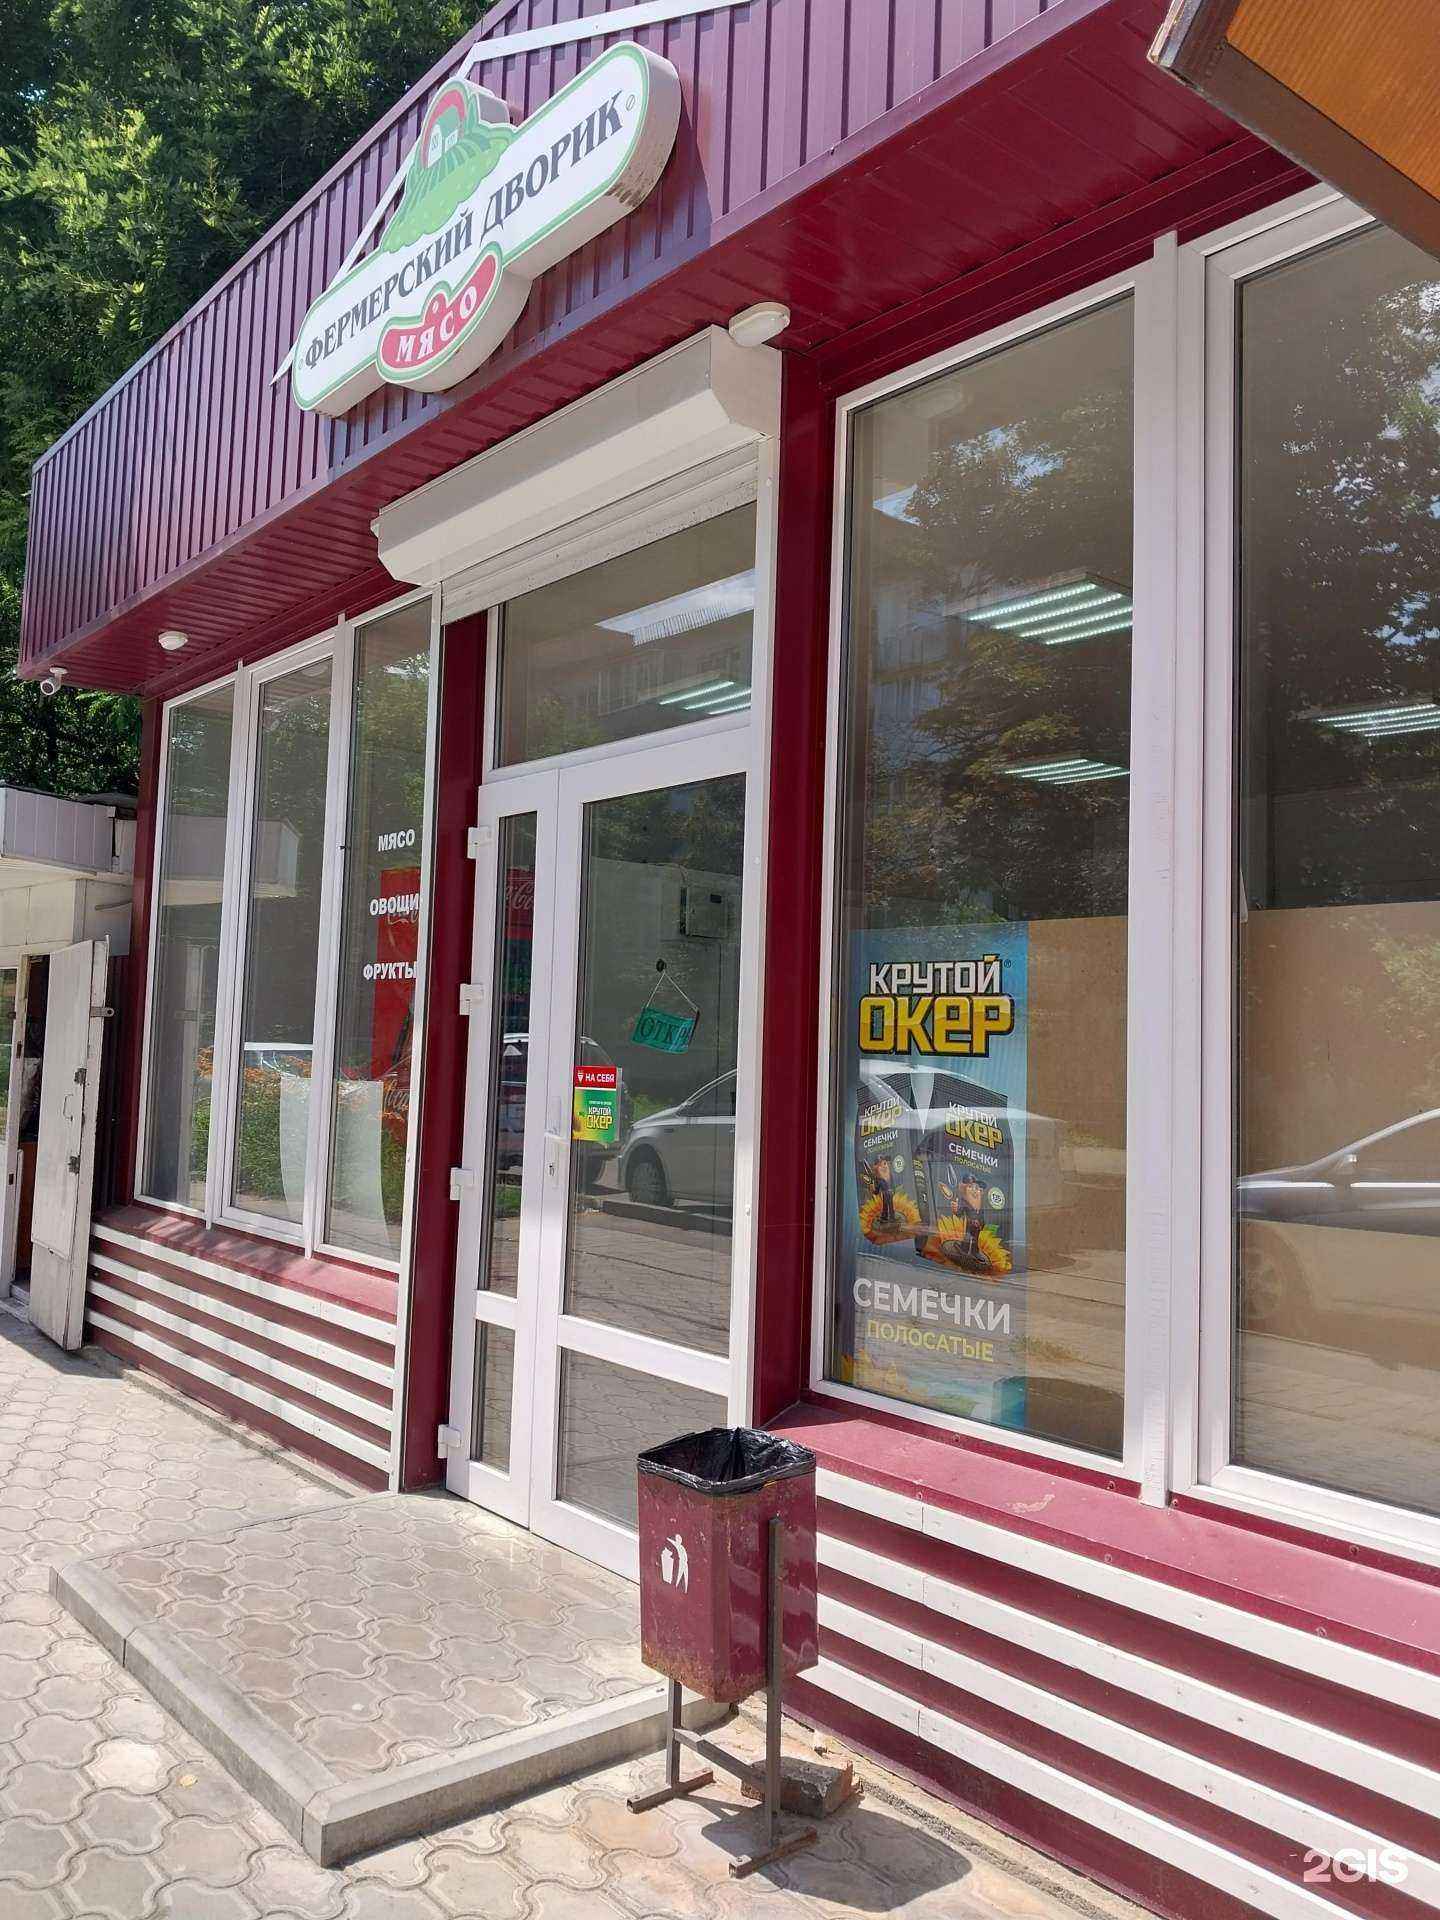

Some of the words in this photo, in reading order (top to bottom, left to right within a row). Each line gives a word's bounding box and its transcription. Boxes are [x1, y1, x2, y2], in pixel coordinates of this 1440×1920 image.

[304, 208, 473, 370] ФЕРМЕРСКИЙ
[480, 90, 624, 247] ДВОРИК
[395, 286, 477, 363] МЯСО
[378, 828, 416, 852] МЯСО
[369, 893, 420, 916] ОВОЩИ
[362, 961, 418, 981] ФРУКТЫ
[869, 954, 1002, 995] КРУТОЙ
[585, 1073, 596, 1082] НА
[597, 1073, 615, 1083] СЕБЯ
[863, 1095, 900, 1118] КРУТОЙ
[949, 1101, 999, 1128] КРУТОЙ
[863, 1130, 899, 1148] СЕМЕЧКИ
[948, 1142, 999, 1168] СЕМЕЧКИ
[853, 1278, 1011, 1334] СЕМЕЧКИ
[867, 1319, 995, 1362] ПОЛОСАТЫЕ
